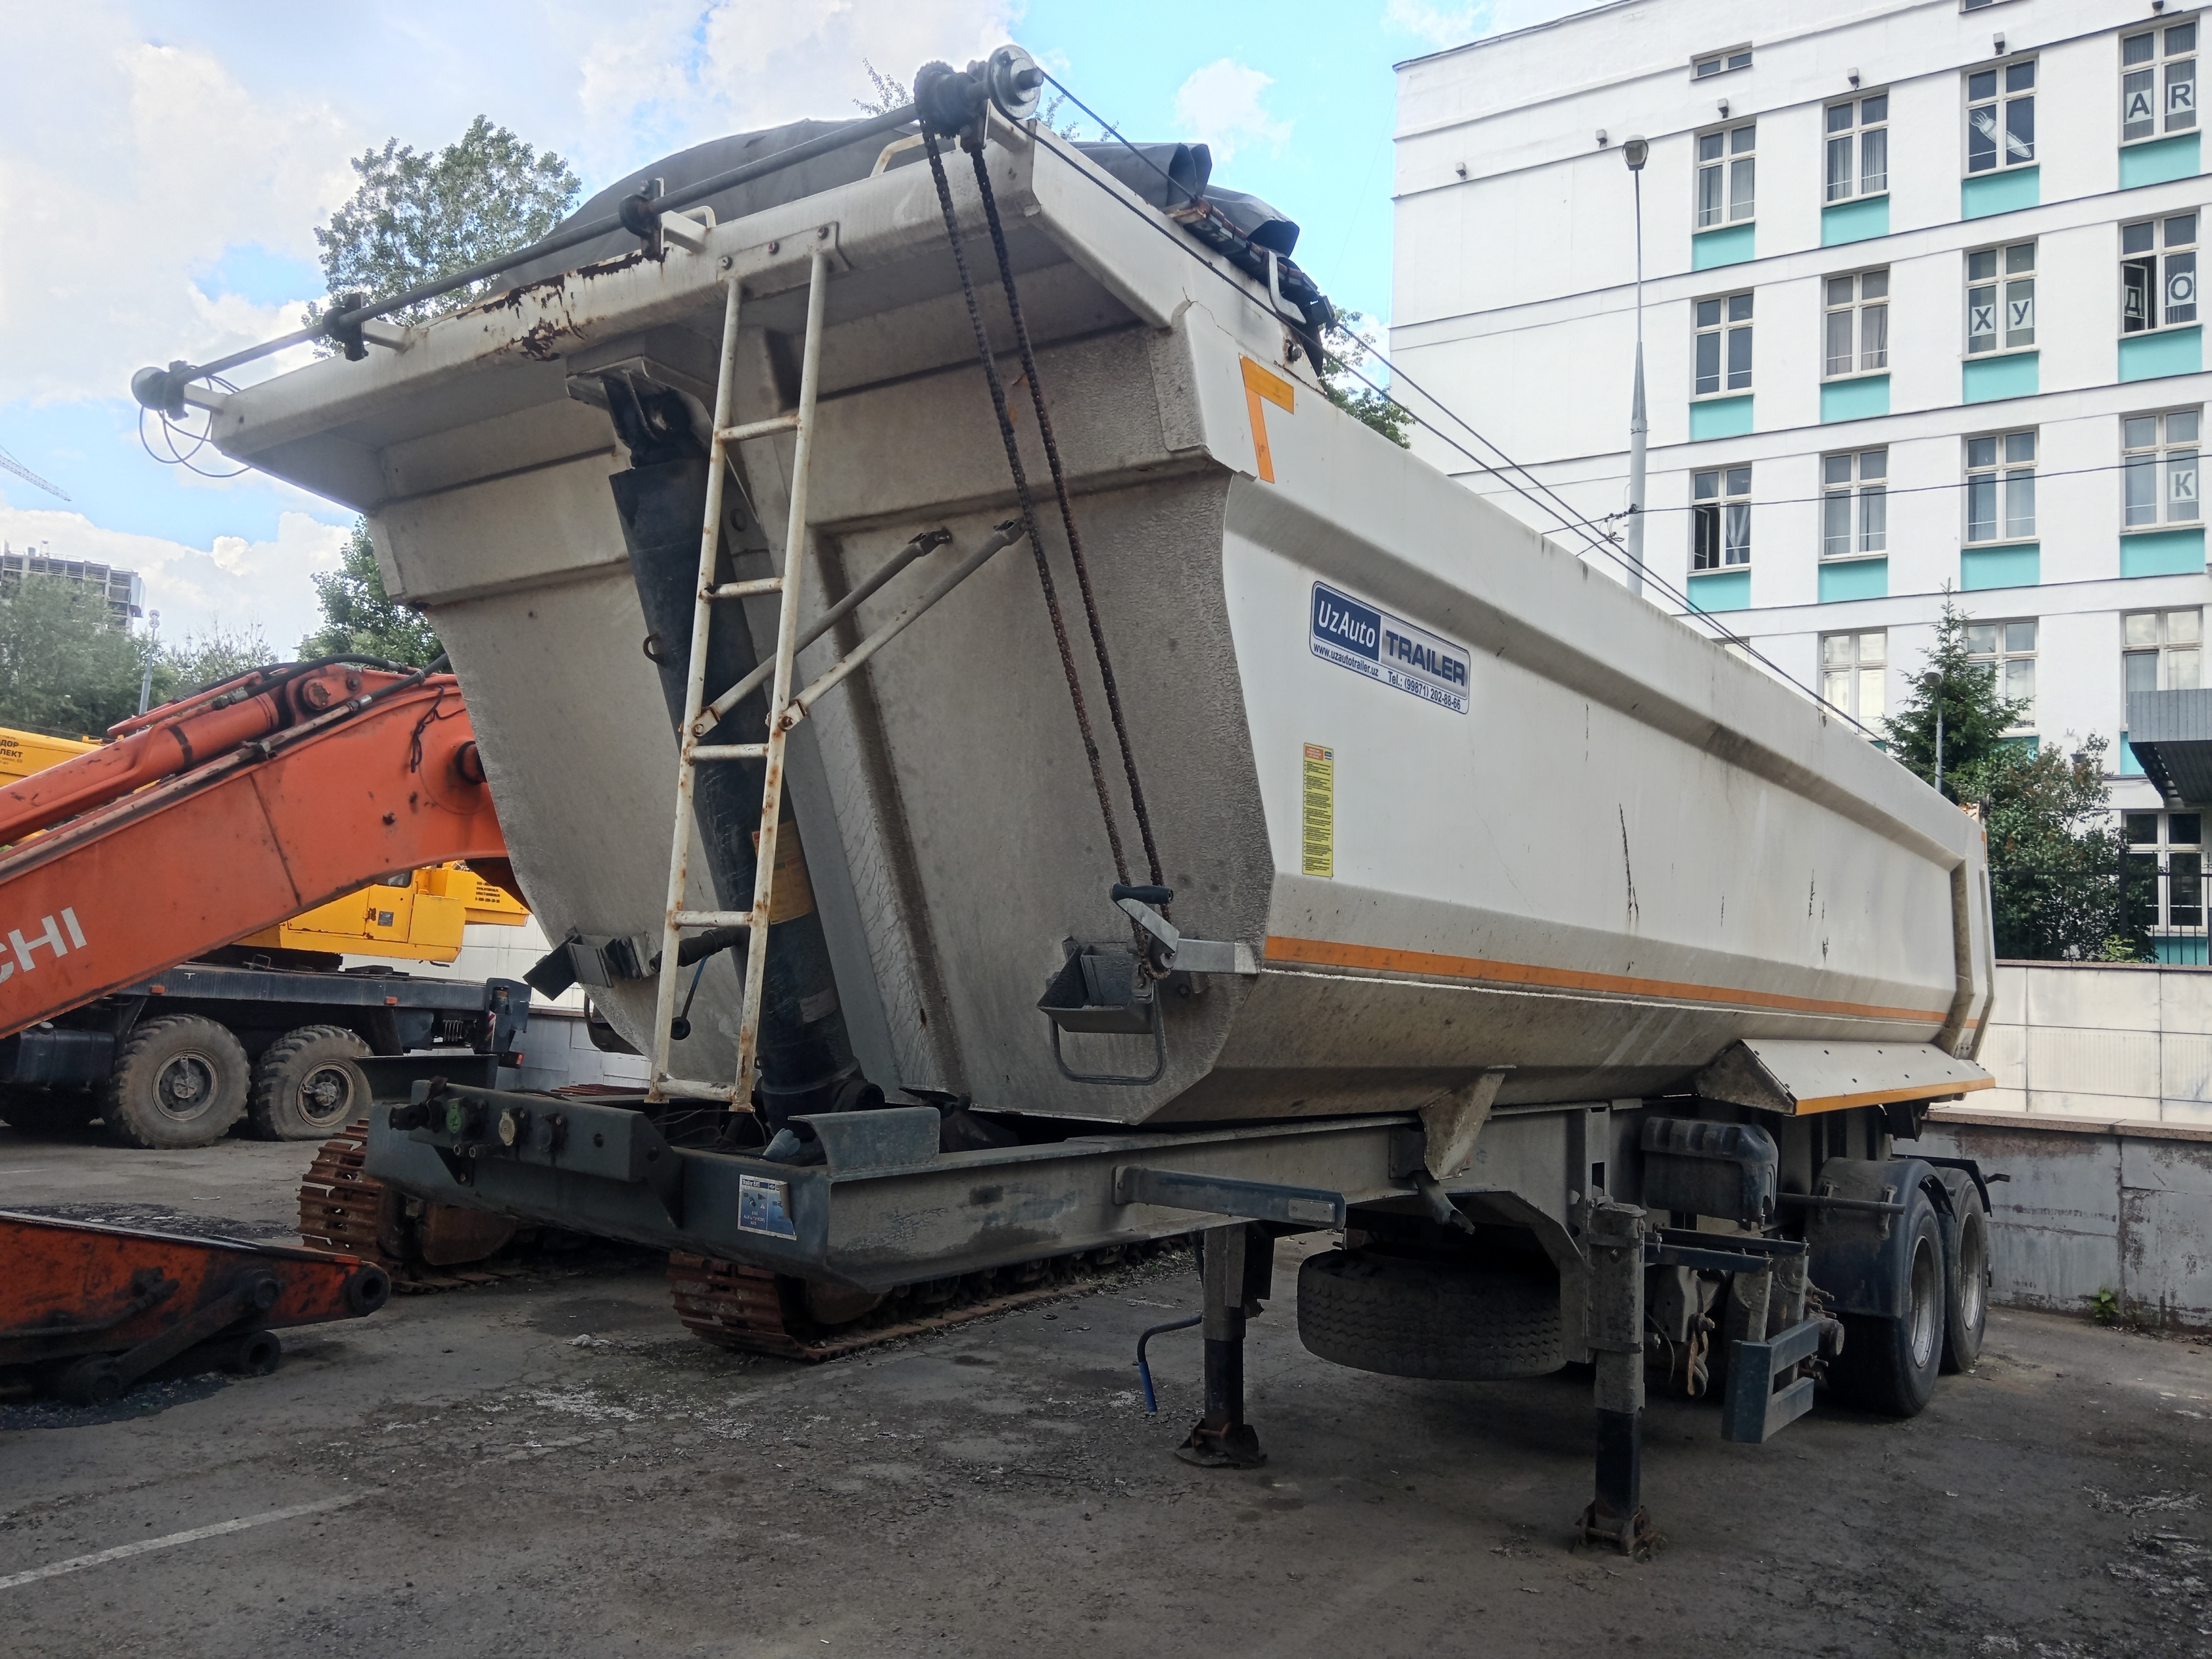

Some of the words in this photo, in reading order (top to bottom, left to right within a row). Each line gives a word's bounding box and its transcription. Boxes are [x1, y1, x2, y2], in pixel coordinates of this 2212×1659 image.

[1313, 643, 1379, 677] www.uzautotrailer.uz
[1388, 670, 1402, 687] Tel.:
[1404, 677, 1429, 698] (99871)
[1431, 688, 1461, 710] 202-88-66
[1318, 600, 1375, 648] UzAuto
[1386, 629, 1465, 687] TRAILER
